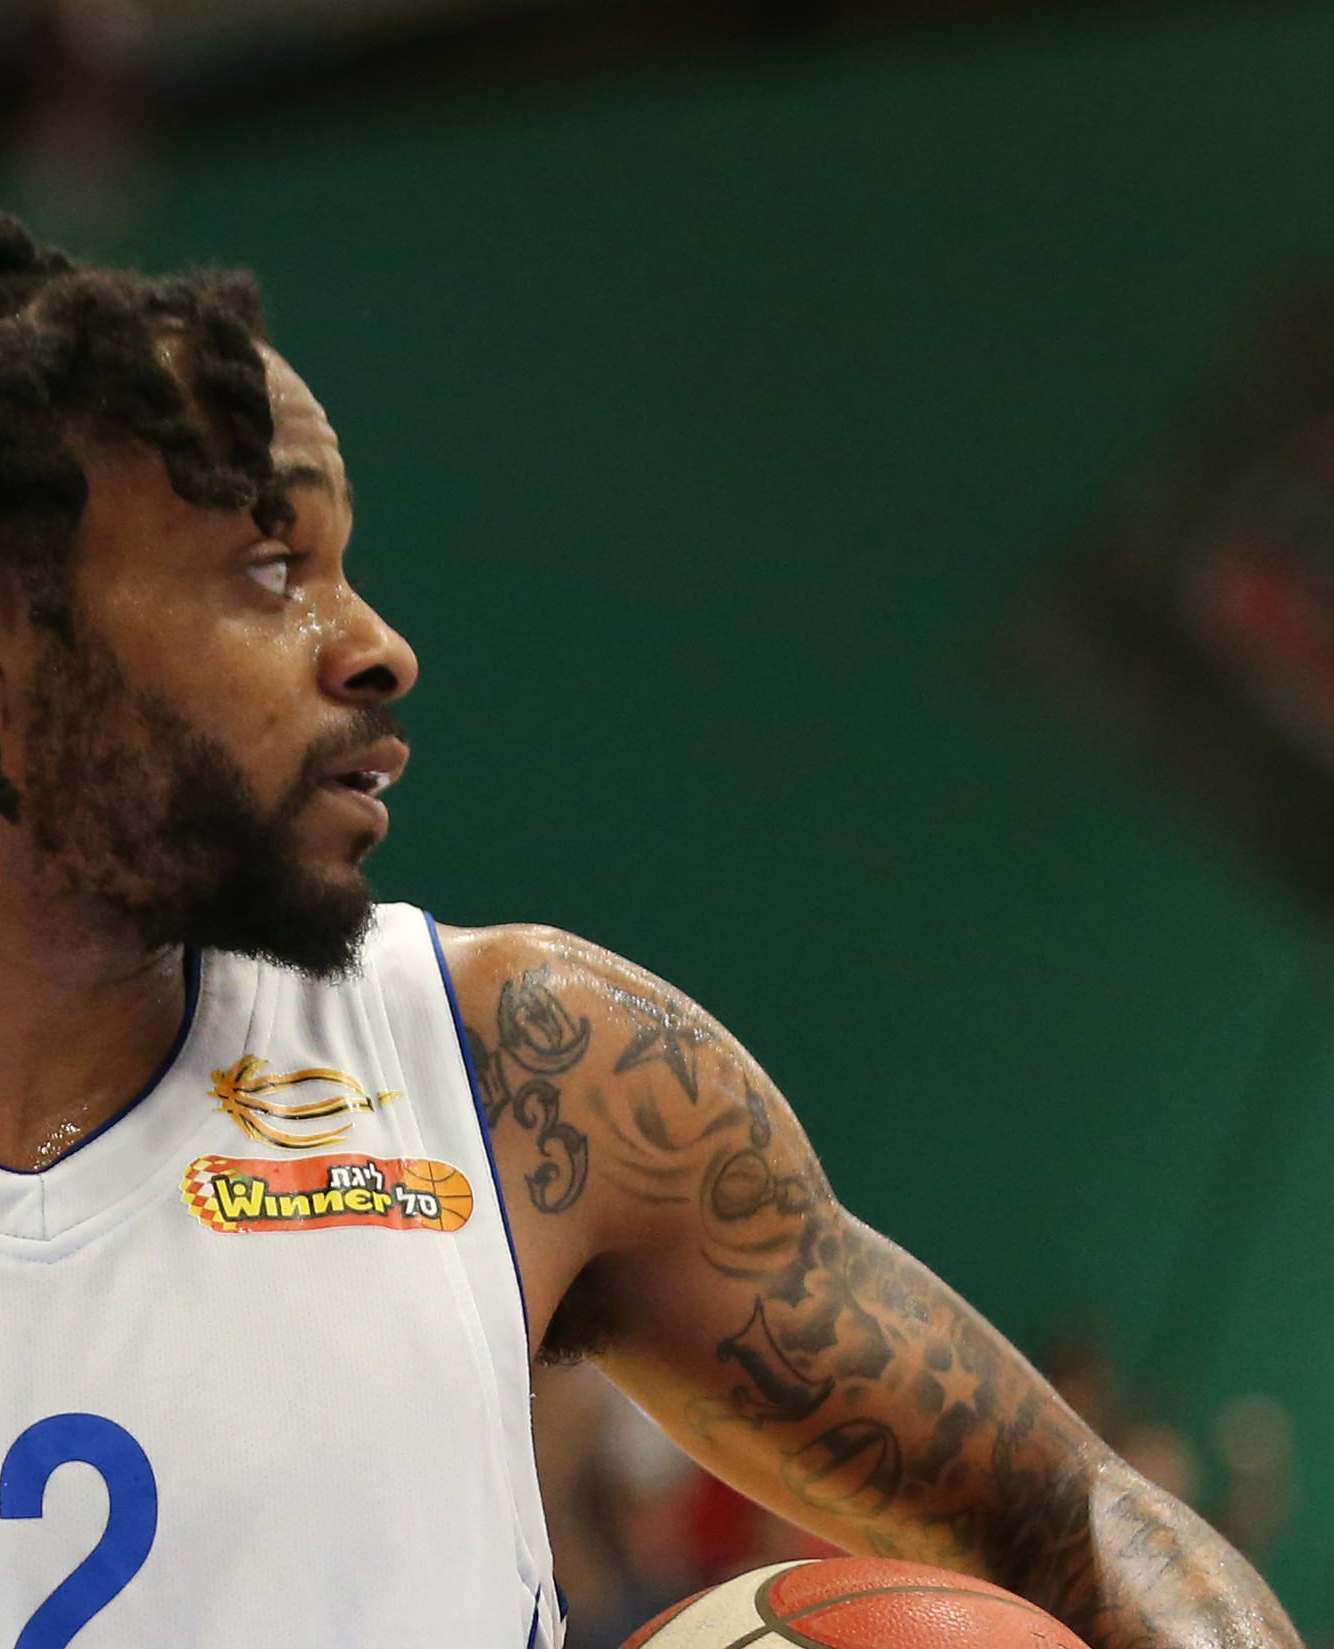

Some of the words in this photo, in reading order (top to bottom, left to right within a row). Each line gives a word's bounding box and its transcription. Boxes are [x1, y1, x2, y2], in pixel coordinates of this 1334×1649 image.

[215, 1180, 393, 1218] Winner
[329, 1162, 384, 1190] ליגת
[396, 1187, 439, 1216] סל
